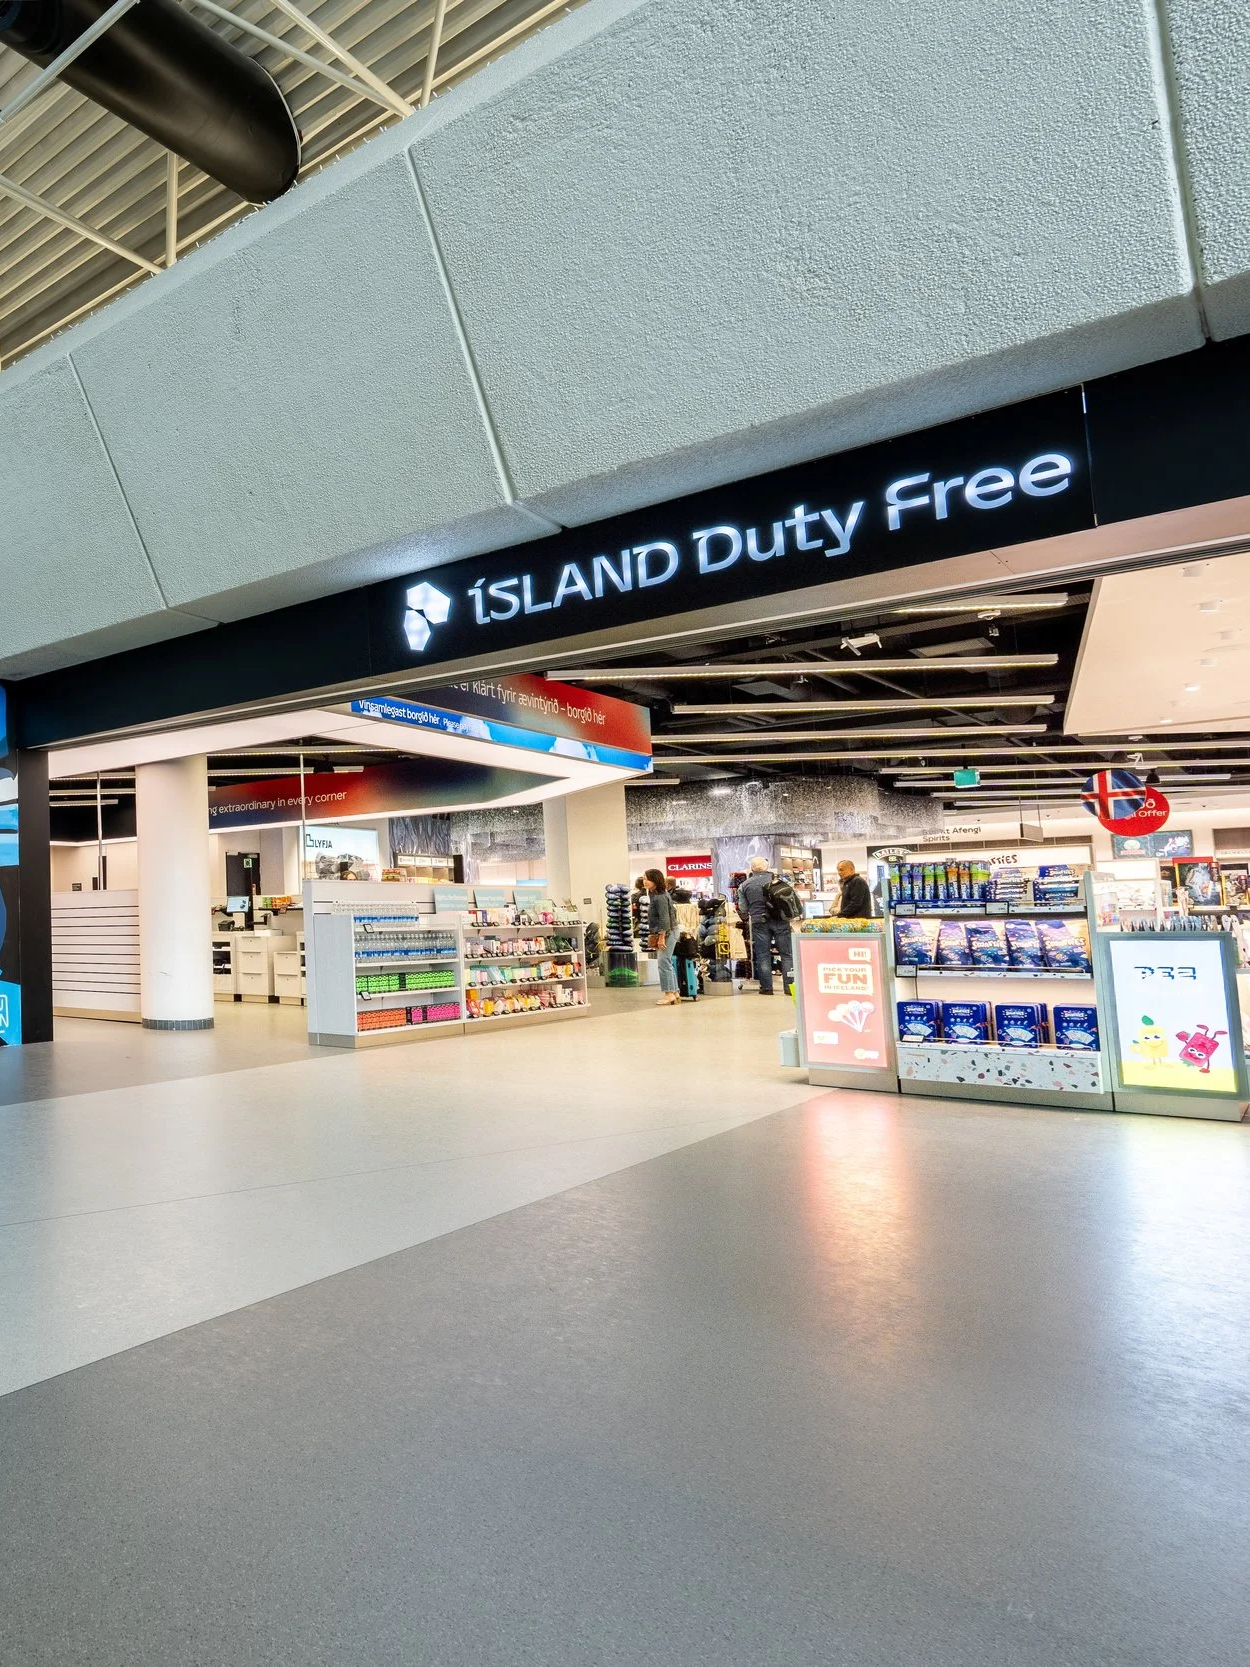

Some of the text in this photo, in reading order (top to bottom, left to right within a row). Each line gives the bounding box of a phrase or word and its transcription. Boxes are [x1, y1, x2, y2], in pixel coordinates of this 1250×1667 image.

[693, 502, 864, 575] Duty
[887, 453, 1072, 531] Free
[497, 685, 517, 705] fyrir
[593, 710, 606, 726] hér
[219, 799, 276, 814] extraordinary
[278, 797, 286, 807] in
[315, 791, 348, 803] corner
[1139, 809, 1167, 818] Offer
[314, 839, 333, 849] LYFJA
[922, 835, 951, 843] Spirits
[667, 862, 713, 871] CLARINS
[823, 973, 868, 985] FUN
